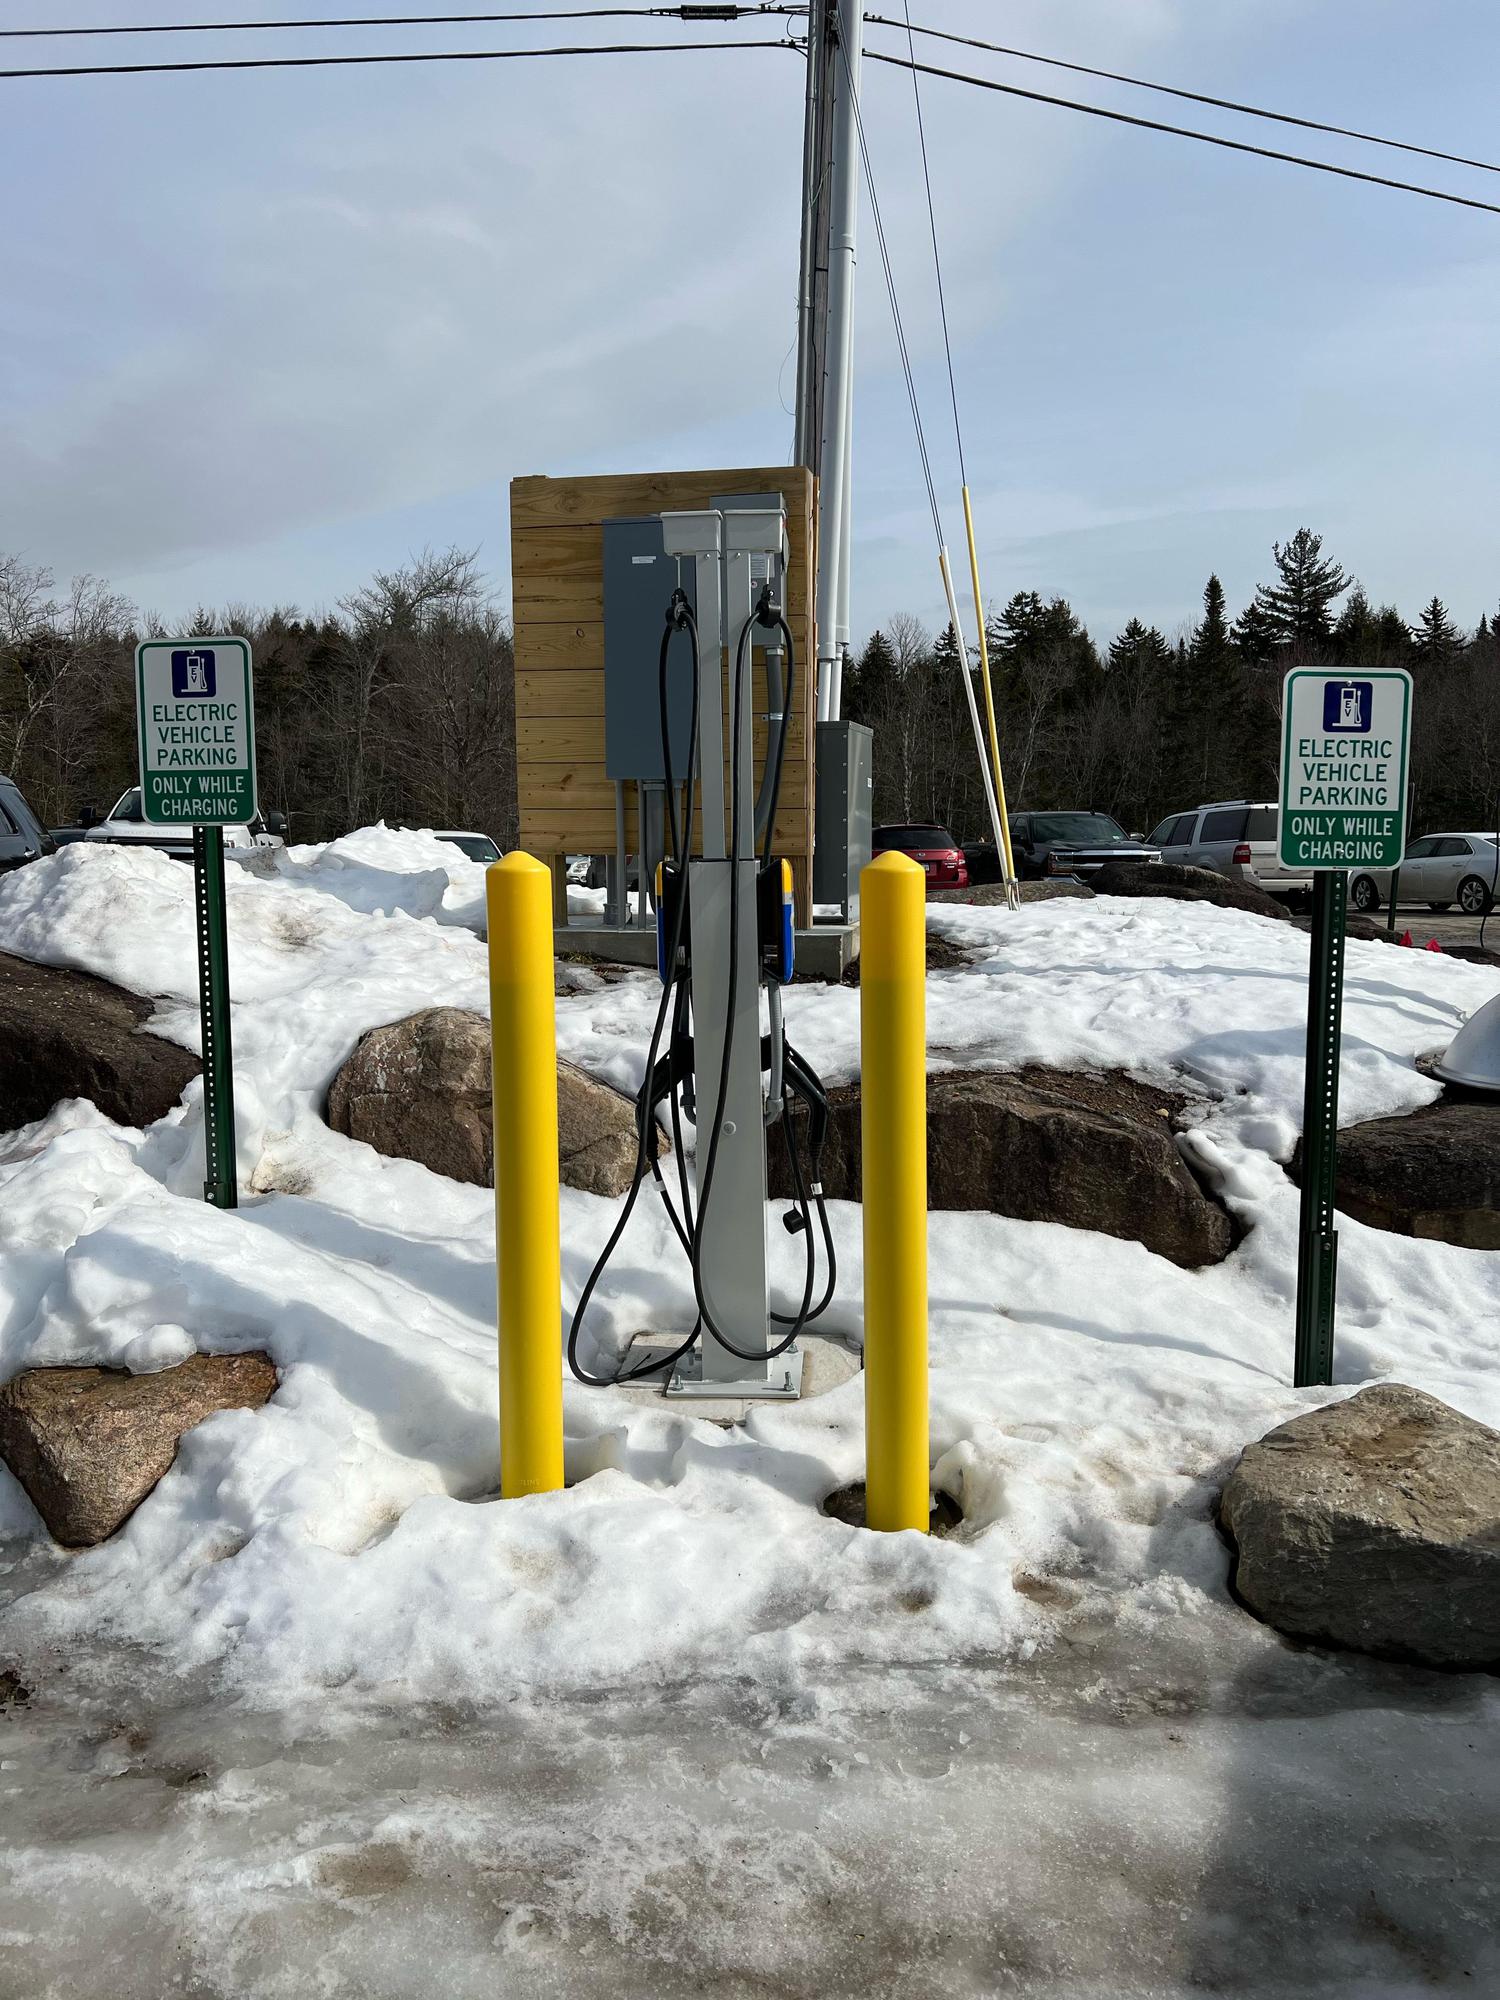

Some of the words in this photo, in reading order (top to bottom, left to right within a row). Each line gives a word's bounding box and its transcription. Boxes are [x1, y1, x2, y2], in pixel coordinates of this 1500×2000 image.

[153, 703, 238, 722] ELECTRIC
[158, 726, 235, 744] VEHICLE
[157, 748, 237, 766] PARKING
[1299, 739, 1392, 758] ELECTRIC
[1303, 763, 1388, 782] VEHICLE
[152, 776, 192, 794] ONLY
[198, 776, 245, 793] WHILE
[1300, 787, 1388, 806] PARKING
[161, 799, 238, 817] CHARGING
[1291, 817, 1336, 836] ONLY
[1343, 818, 1393, 836] WHILE
[1299, 841, 1384, 860] CHARGING
